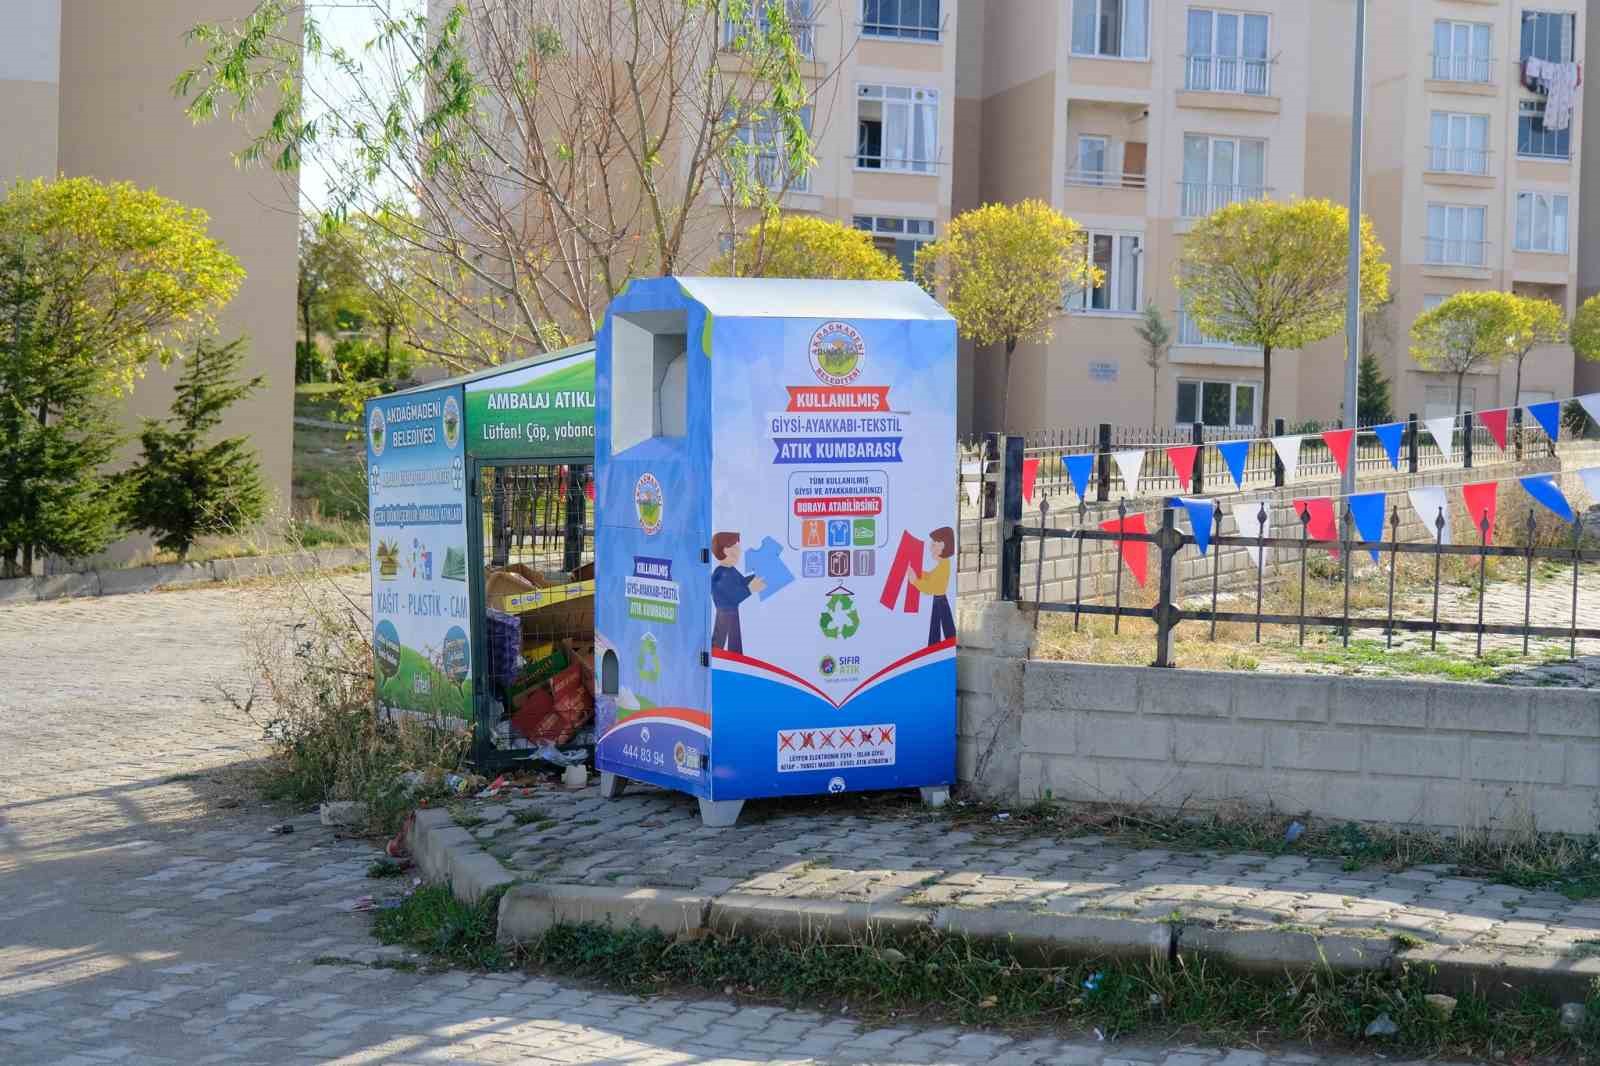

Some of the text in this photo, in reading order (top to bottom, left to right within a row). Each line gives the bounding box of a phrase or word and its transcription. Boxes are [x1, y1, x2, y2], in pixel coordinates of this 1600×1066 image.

[487, 393, 550, 410] AMBALAJ
[796, 392, 880, 410] KULLANILMIŞ
[386, 397, 441, 424] AKDAĞMADENİ
[483, 423, 522, 440] Lütfen!
[526, 422, 550, 442] Çöp,
[771, 414, 902, 433] GİYSİ-AYAKKABI-TEKSTİL
[391, 425, 437, 448] BELEDİYESİ
[781, 442, 896, 459] ATIK KUMBARASI
[826, 475, 869, 487] KULLANILMIŞ
[797, 501, 827, 513] BURAYA
[377, 588, 399, 614] KAĞIT
[408, 590, 441, 616] PLASTİK
[450, 595, 467, 618] CAM
[839, 655, 860, 665] SIFIR
[622, 743, 664, 767] 444 83 94
